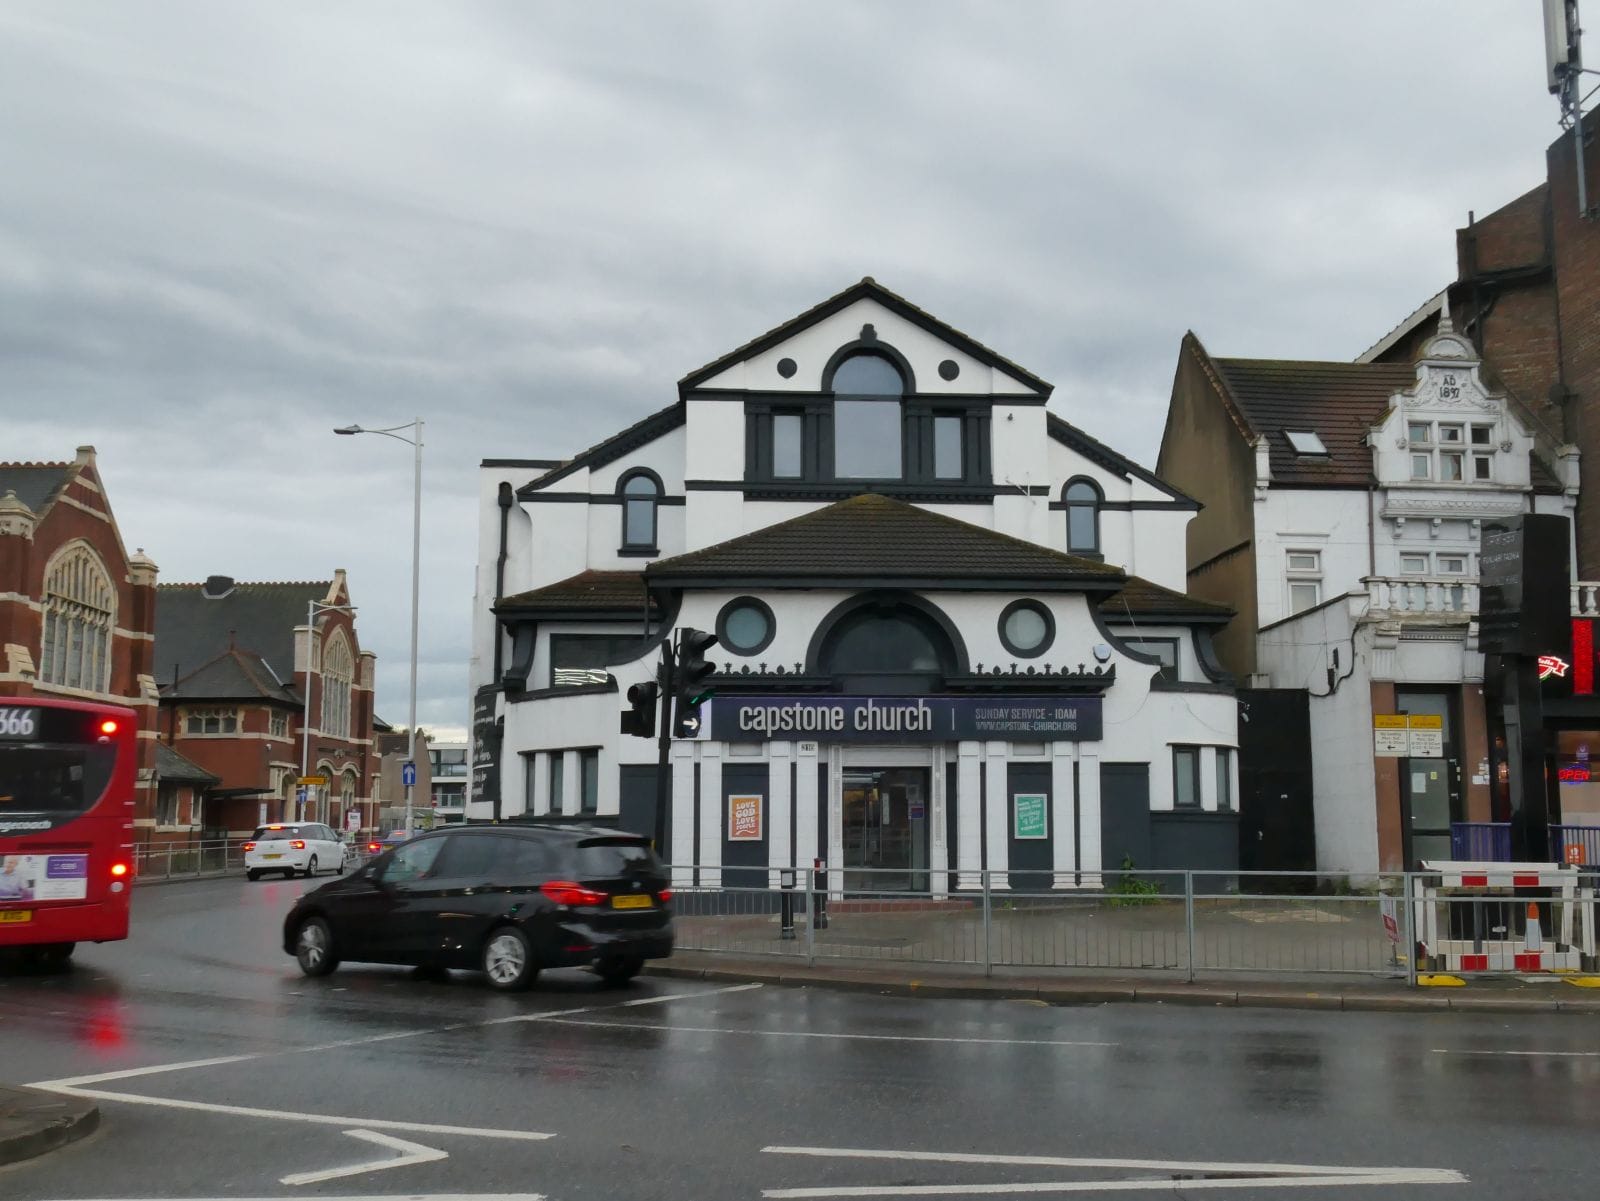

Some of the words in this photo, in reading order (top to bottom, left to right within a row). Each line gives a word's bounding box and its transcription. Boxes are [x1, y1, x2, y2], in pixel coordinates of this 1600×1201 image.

[1440, 386, 1460, 399] 1897
[739, 702, 844, 737] capstone
[854, 698, 931, 731] church
[975, 708, 1009, 720] SUNDAY
[1011, 708, 1046, 720] SERVICE
[975, 721, 1077, 731] WWW.CAPSTONE-CHURCH.ORG
[736, 801, 756, 810] LOVE
[735, 808, 756, 818] GOD
[736, 816, 756, 825] LOVE
